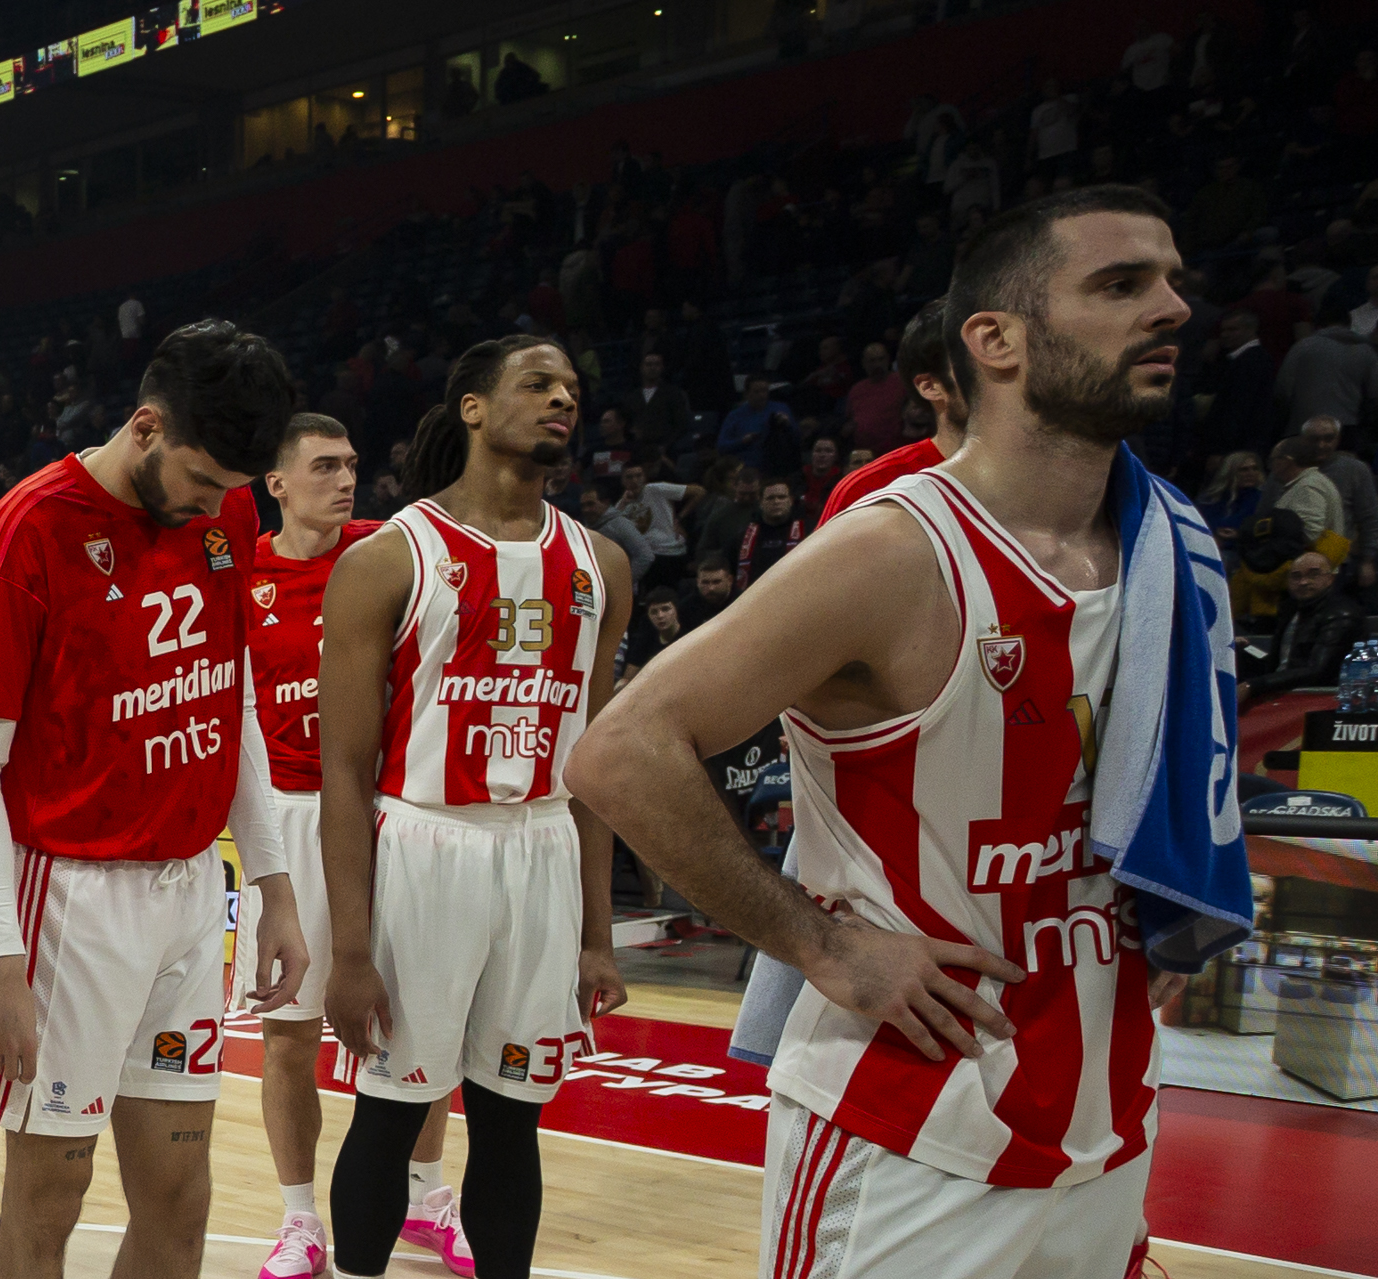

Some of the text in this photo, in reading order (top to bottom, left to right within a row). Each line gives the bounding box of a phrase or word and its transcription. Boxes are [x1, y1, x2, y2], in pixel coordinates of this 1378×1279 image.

[141, 583, 207, 659] 22
[487, 598, 553, 652] 33
[112, 657, 236, 722] meridian
[439, 666, 581, 711] meridian
[145, 716, 222, 775] mts
[465, 717, 551, 758] mts
